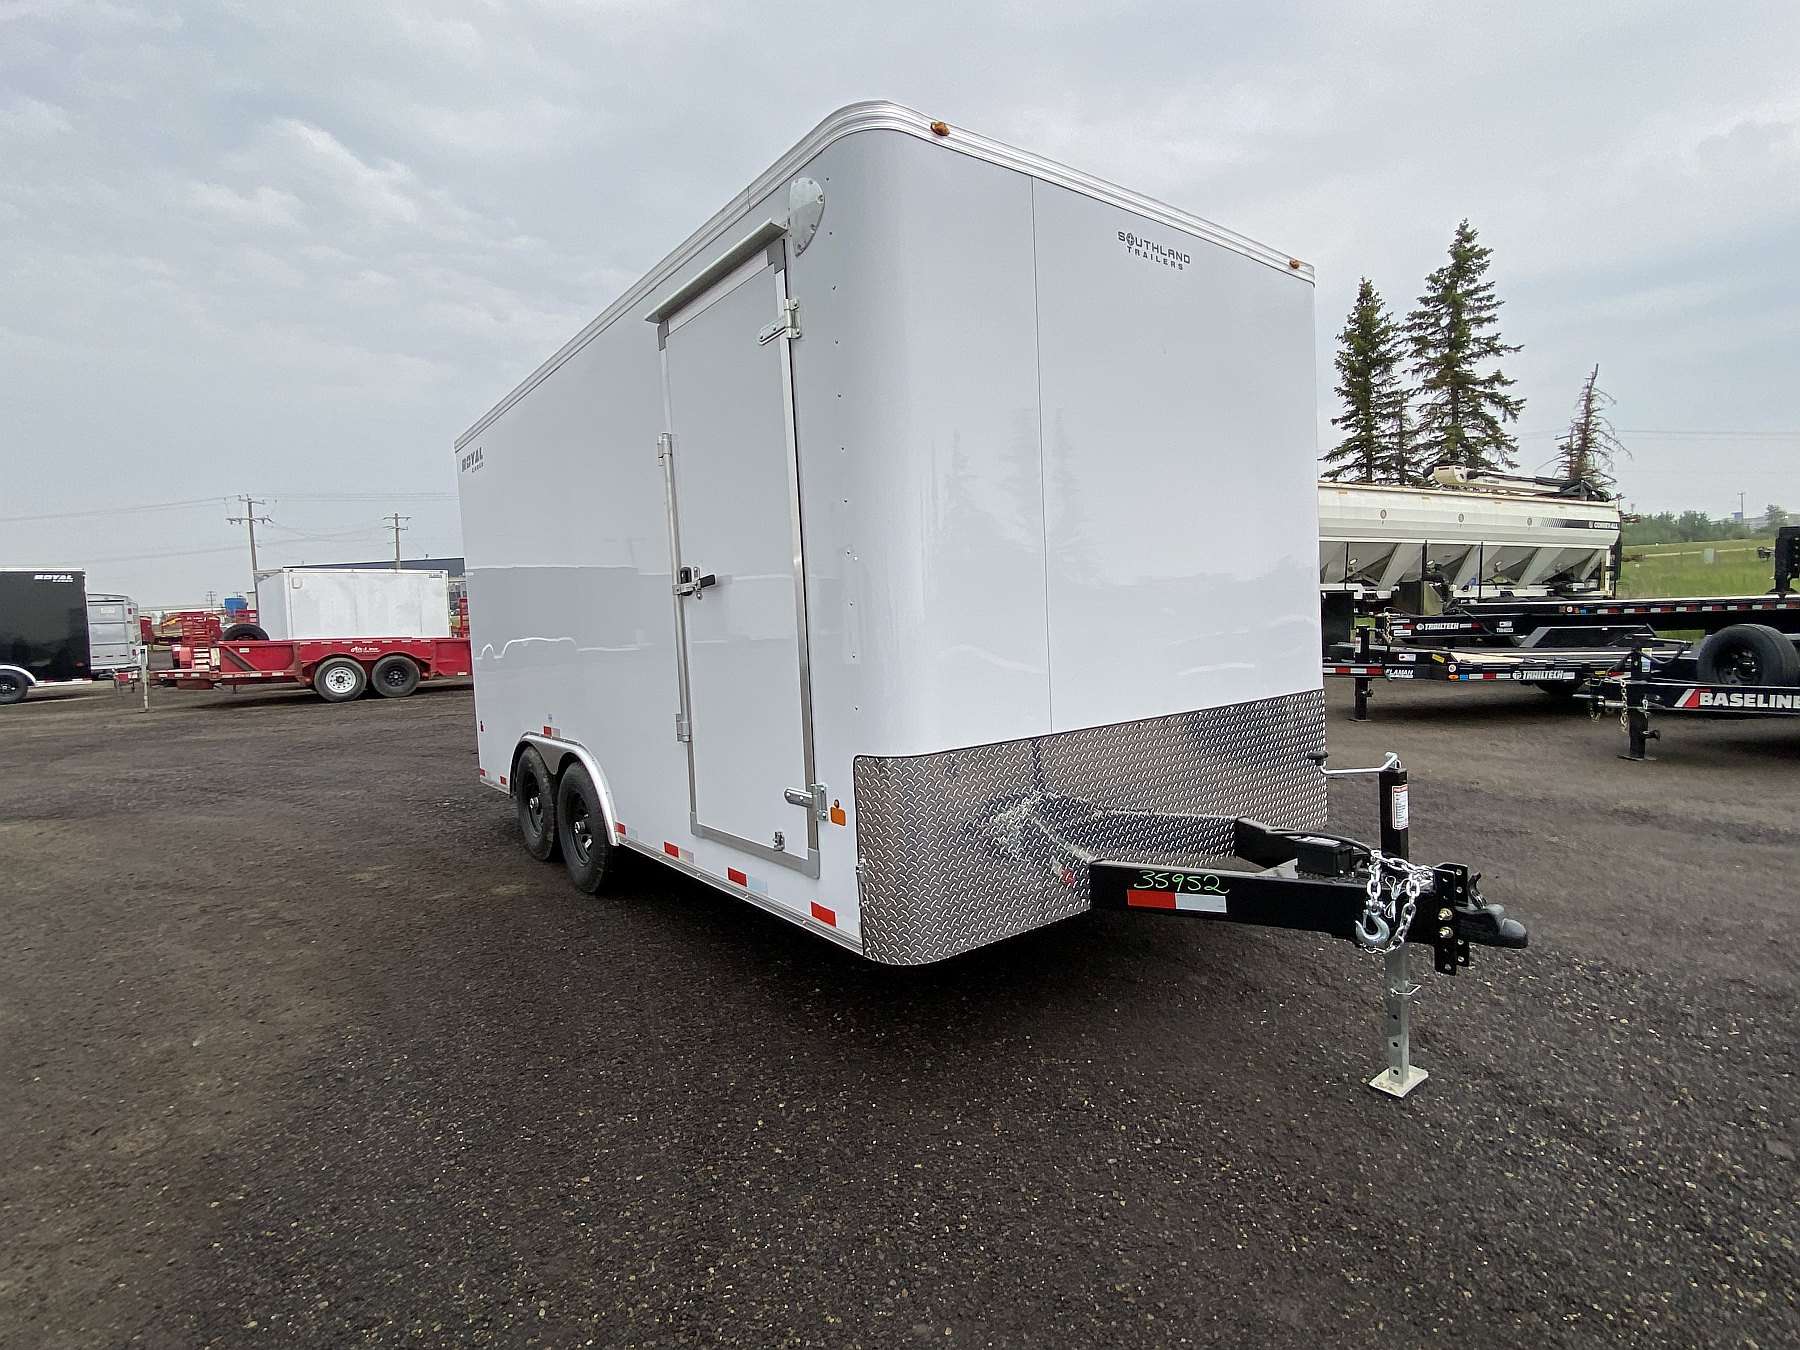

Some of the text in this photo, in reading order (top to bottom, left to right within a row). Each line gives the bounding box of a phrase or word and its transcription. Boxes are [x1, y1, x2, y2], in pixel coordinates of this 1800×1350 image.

[1118, 231, 1190, 264] SOUTHLAND
[1127, 246, 1183, 270] TRAILERS
[1522, 670, 1564, 680] TRAILTECH
[1134, 870, 1230, 894] 35952
